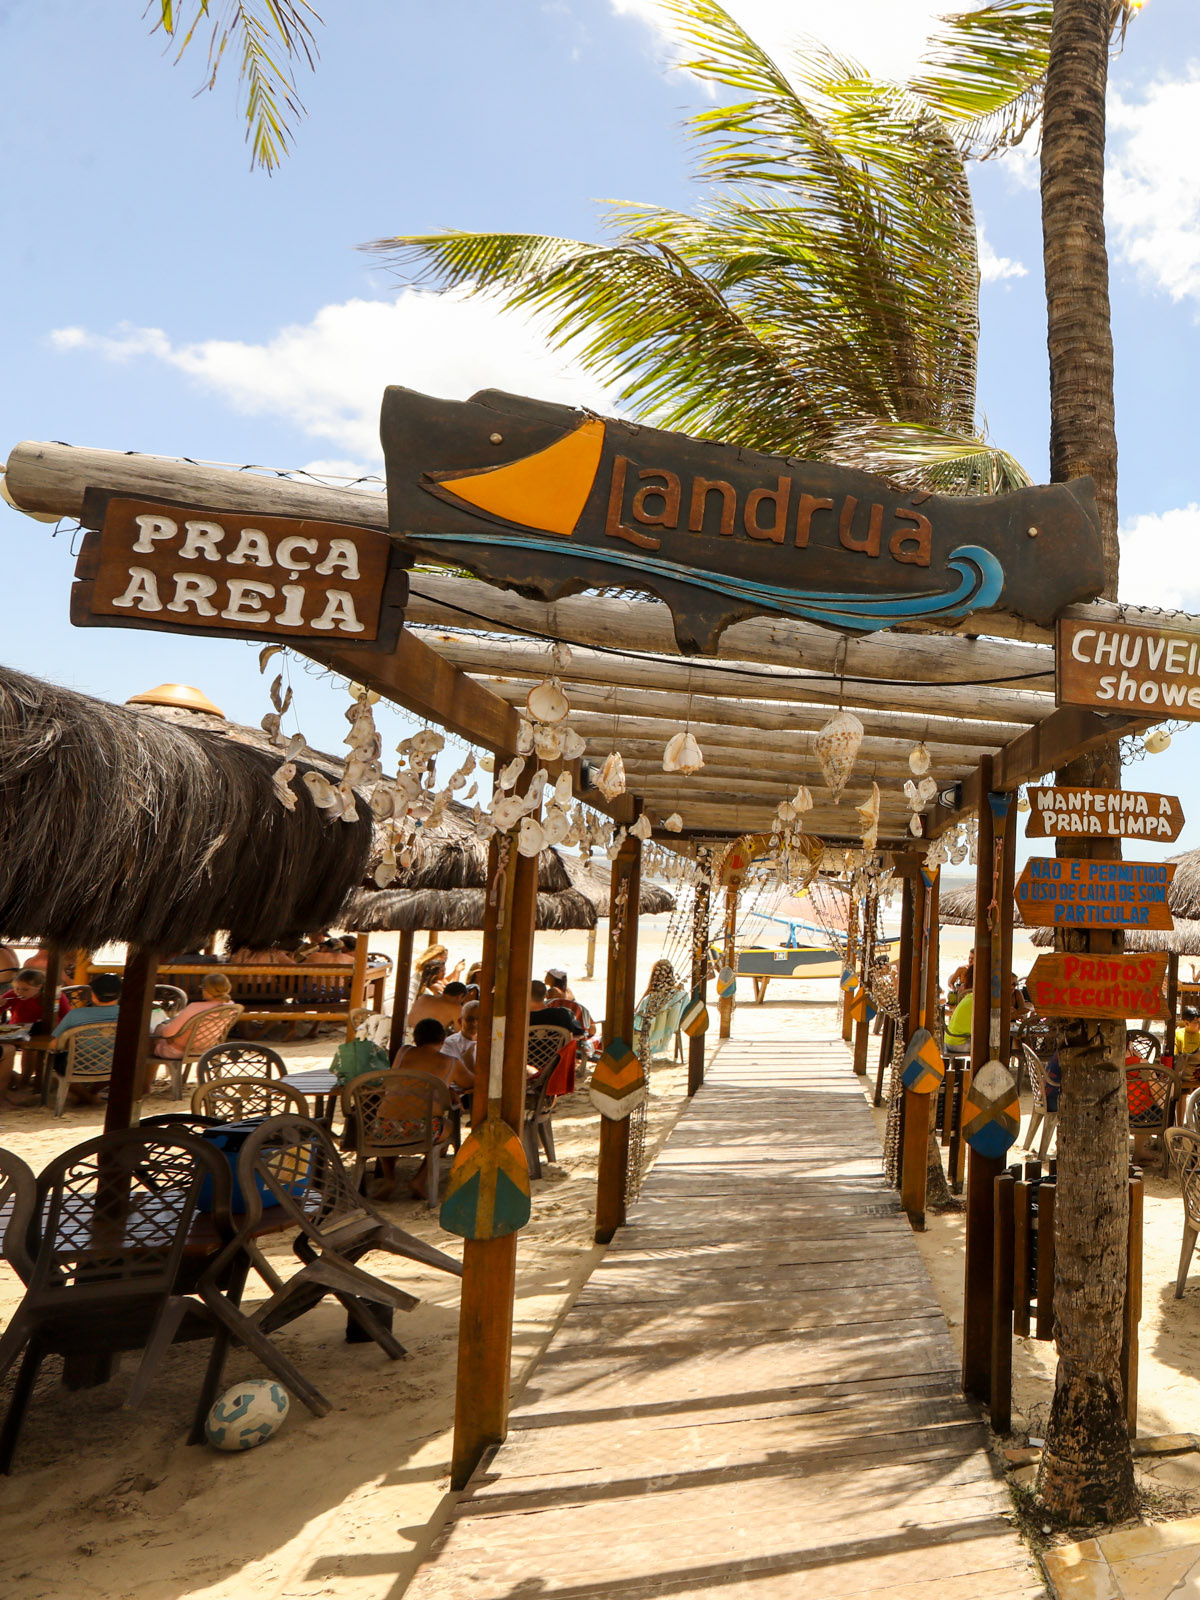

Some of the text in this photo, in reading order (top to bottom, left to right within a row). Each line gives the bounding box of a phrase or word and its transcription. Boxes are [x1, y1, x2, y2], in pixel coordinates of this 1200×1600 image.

[605, 453, 933, 568] Landruá
[132, 514, 361, 580] PRAÇA
[112, 566, 365, 633] AREIA
[1159, 797, 1172, 815] A
[1030, 858, 1062, 880] NÃO
[1070, 858, 1081, 881] É
[1019, 882, 1166, 904] O USO DE CAIXA DE SOM
[1054, 904, 1150, 924] PARTICULAR
[1064, 956, 1156, 983] PRATOS
